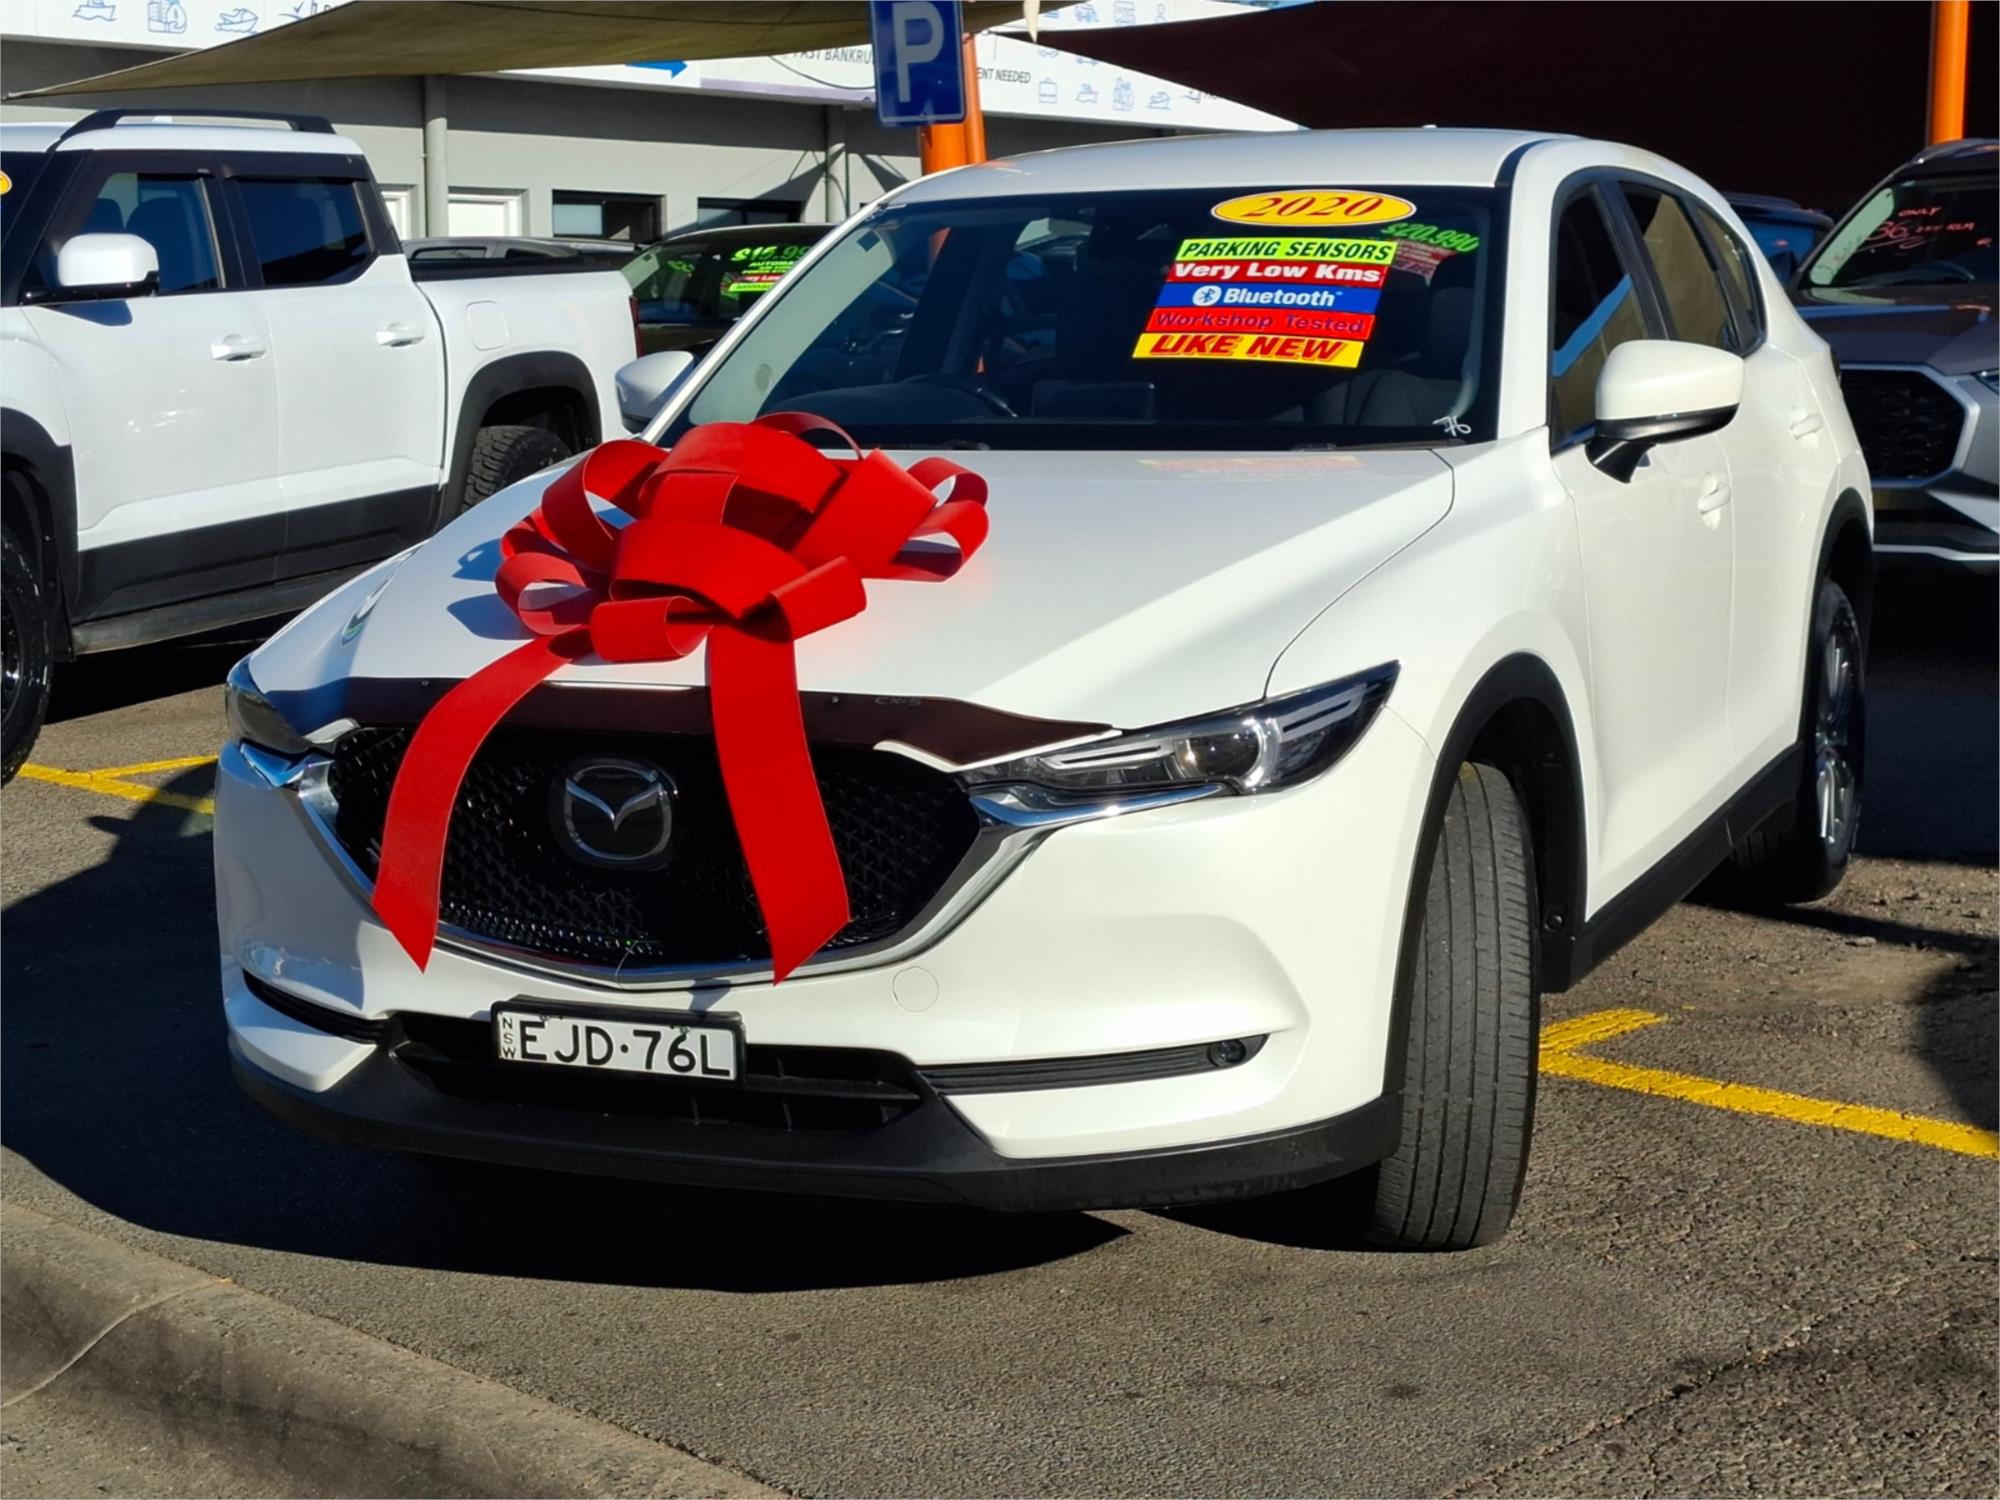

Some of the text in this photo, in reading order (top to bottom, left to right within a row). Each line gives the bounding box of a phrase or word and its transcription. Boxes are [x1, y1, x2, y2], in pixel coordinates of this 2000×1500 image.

[893, 2, 944, 103] P
[995, 69, 1032, 84] NEEDED
[1241, 196, 1384, 218] 2020
[1181, 241, 1282, 258] PARKING
[1285, 242, 1393, 261] SENSORS
[1173, 262, 1382, 282] Very Low Kms
[1155, 312, 1364, 333] Workshop Tested
[1149, 334, 1346, 361] LIKE NEW
